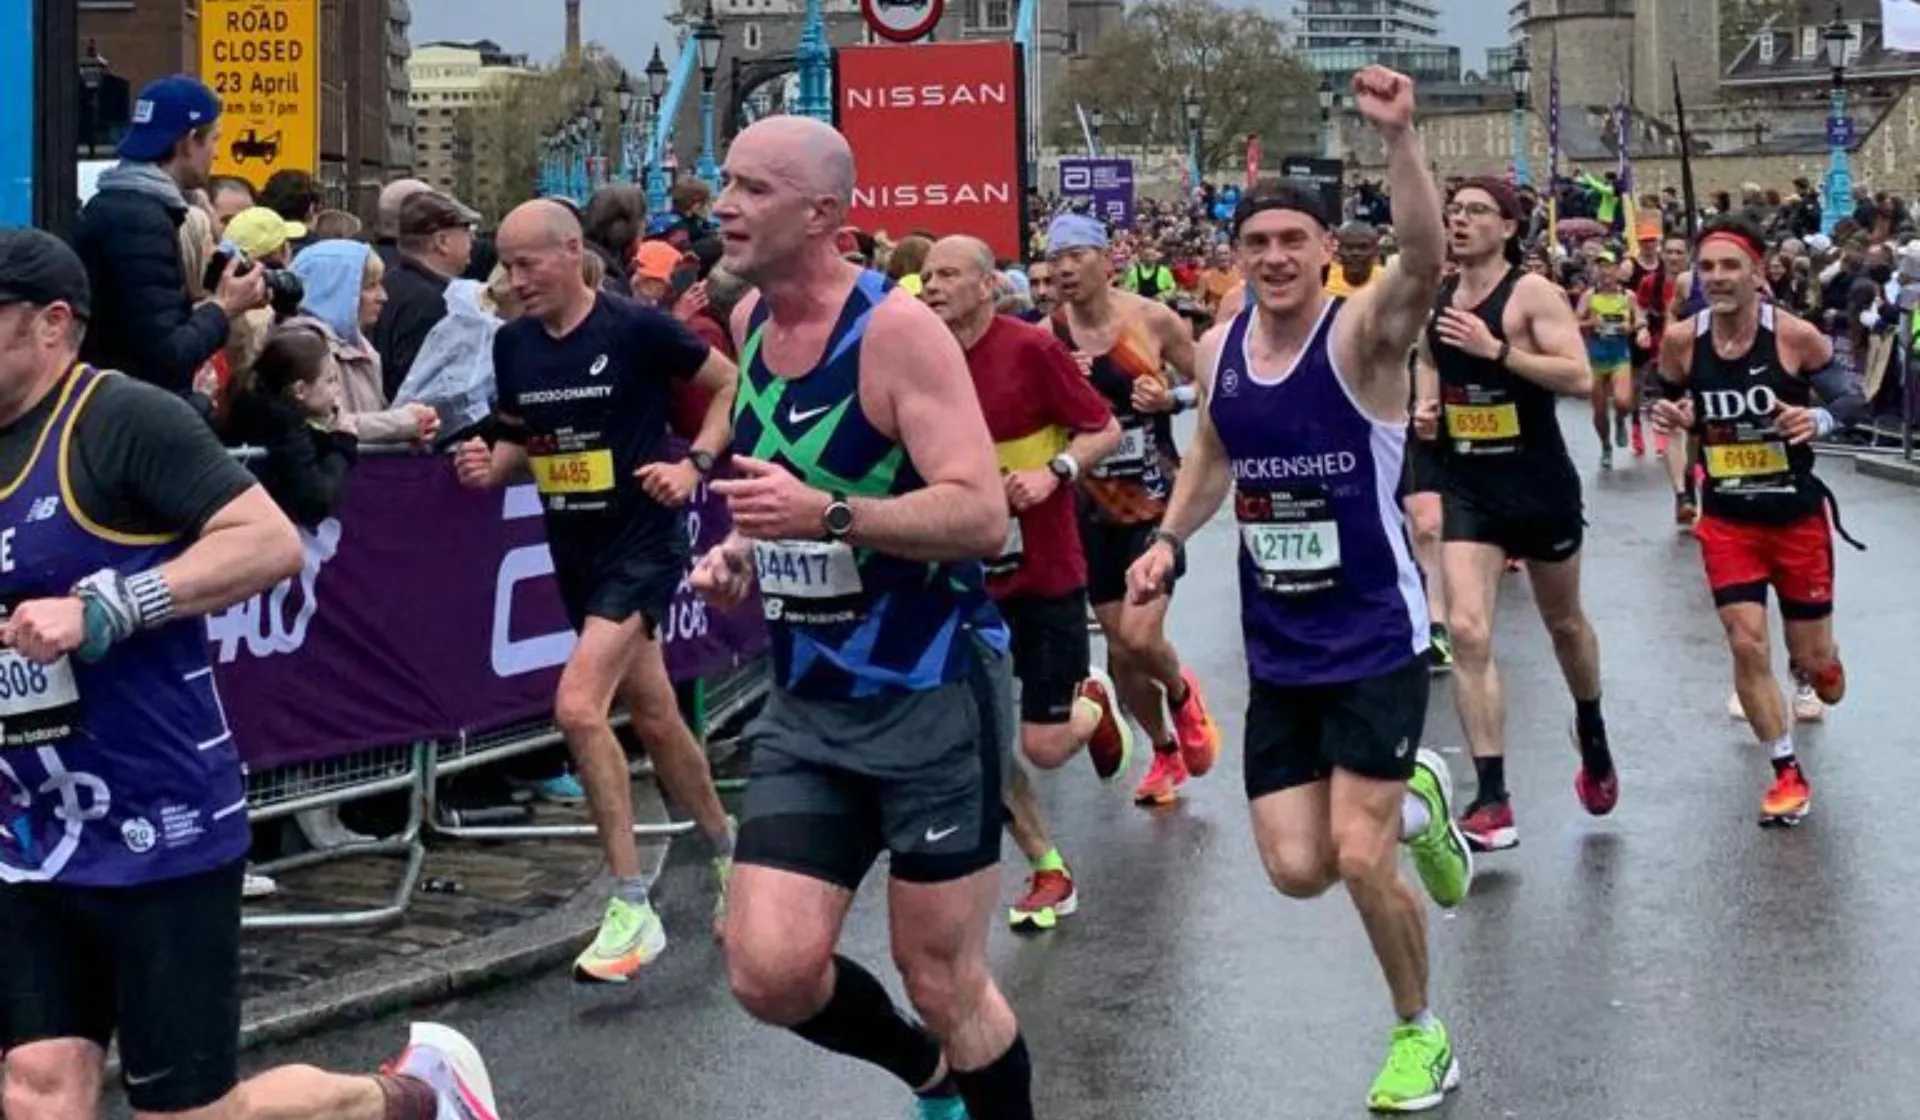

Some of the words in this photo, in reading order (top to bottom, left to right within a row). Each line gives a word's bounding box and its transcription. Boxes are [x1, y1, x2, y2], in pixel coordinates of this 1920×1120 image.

[226, 11, 288, 32] ROAD
[212, 40, 303, 63] CLOSED
[215, 72, 241, 93] 23
[251, 72, 299, 98] April
[847, 83, 1005, 109] NISSAN
[249, 100, 263, 115] to
[851, 182, 1009, 208] NISSAN
[1700, 384, 1777, 420] IDO
